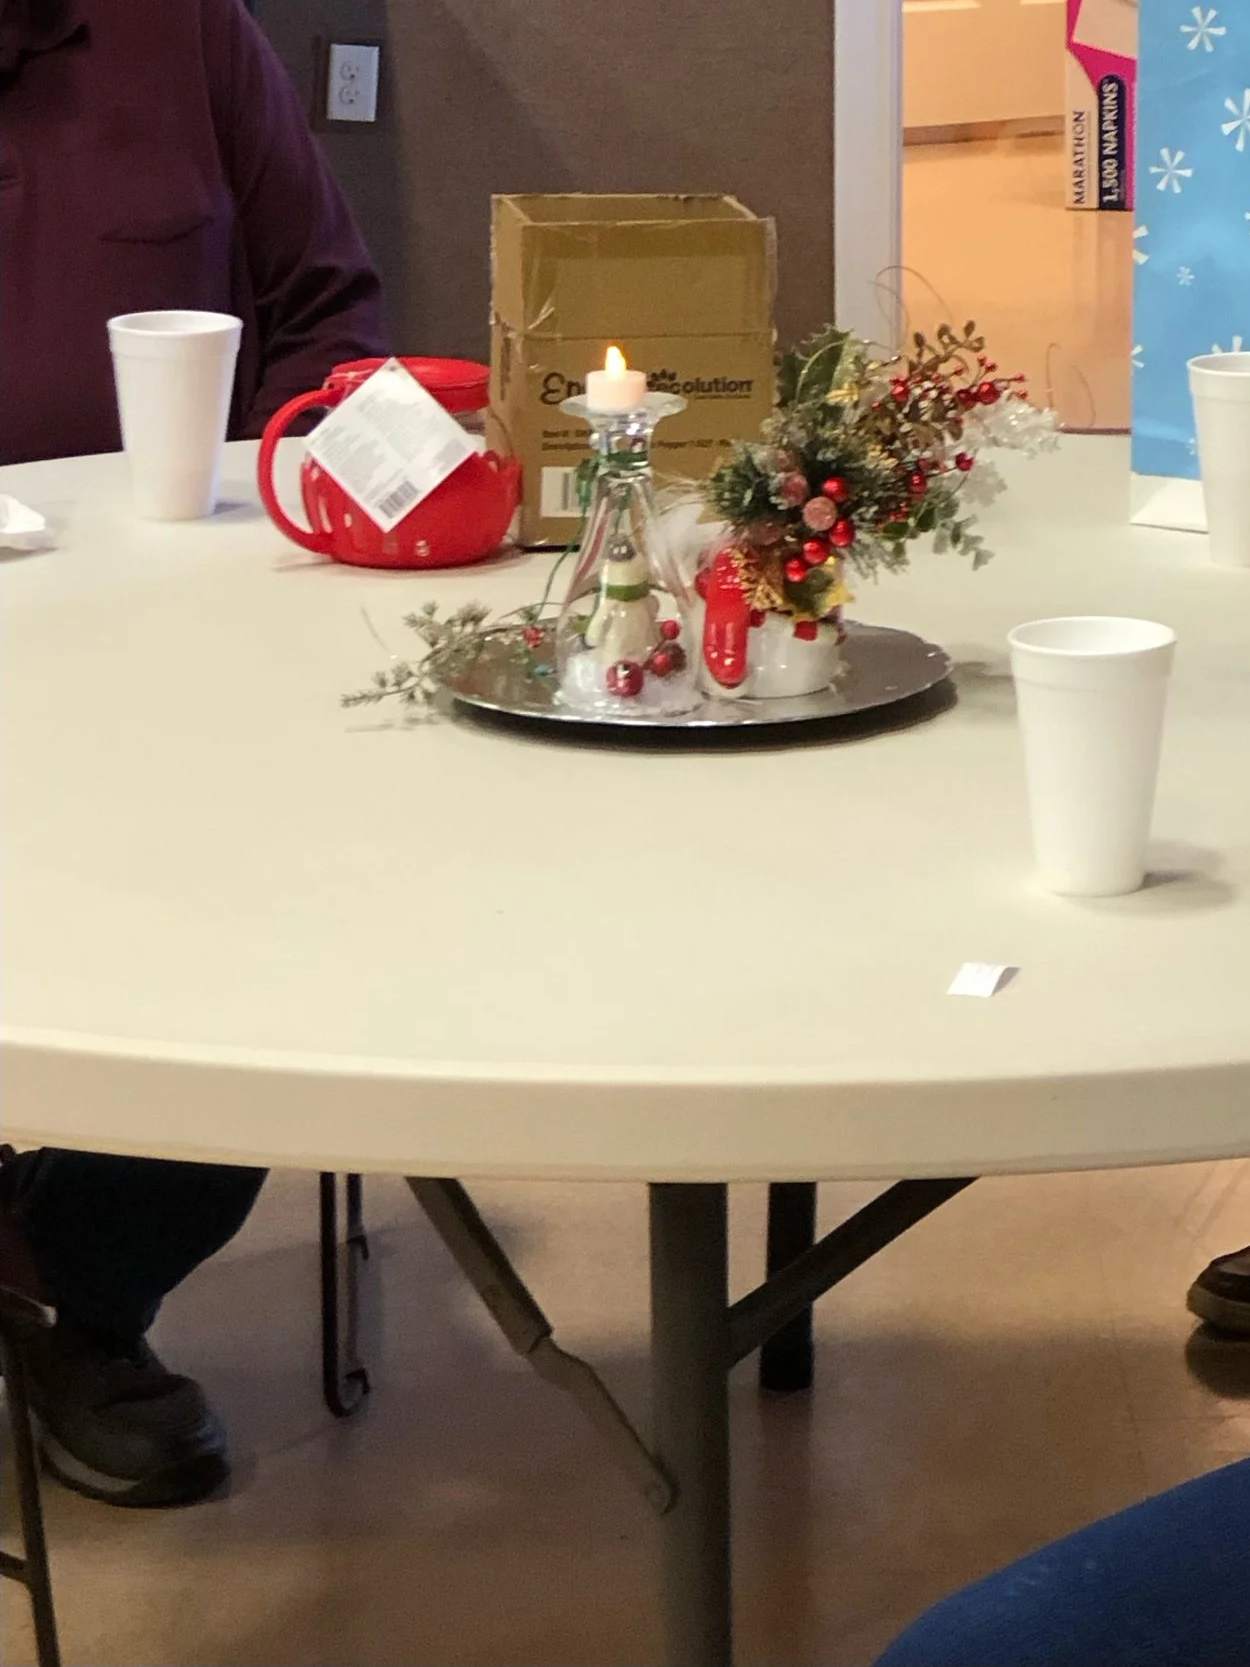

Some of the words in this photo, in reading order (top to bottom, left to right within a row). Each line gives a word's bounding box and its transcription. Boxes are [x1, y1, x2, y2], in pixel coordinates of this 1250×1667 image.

[1101, 82, 1119, 155] NAPKINS
[1072, 110, 1086, 205] MARATHON
[1102, 157, 1121, 203] 1,500
